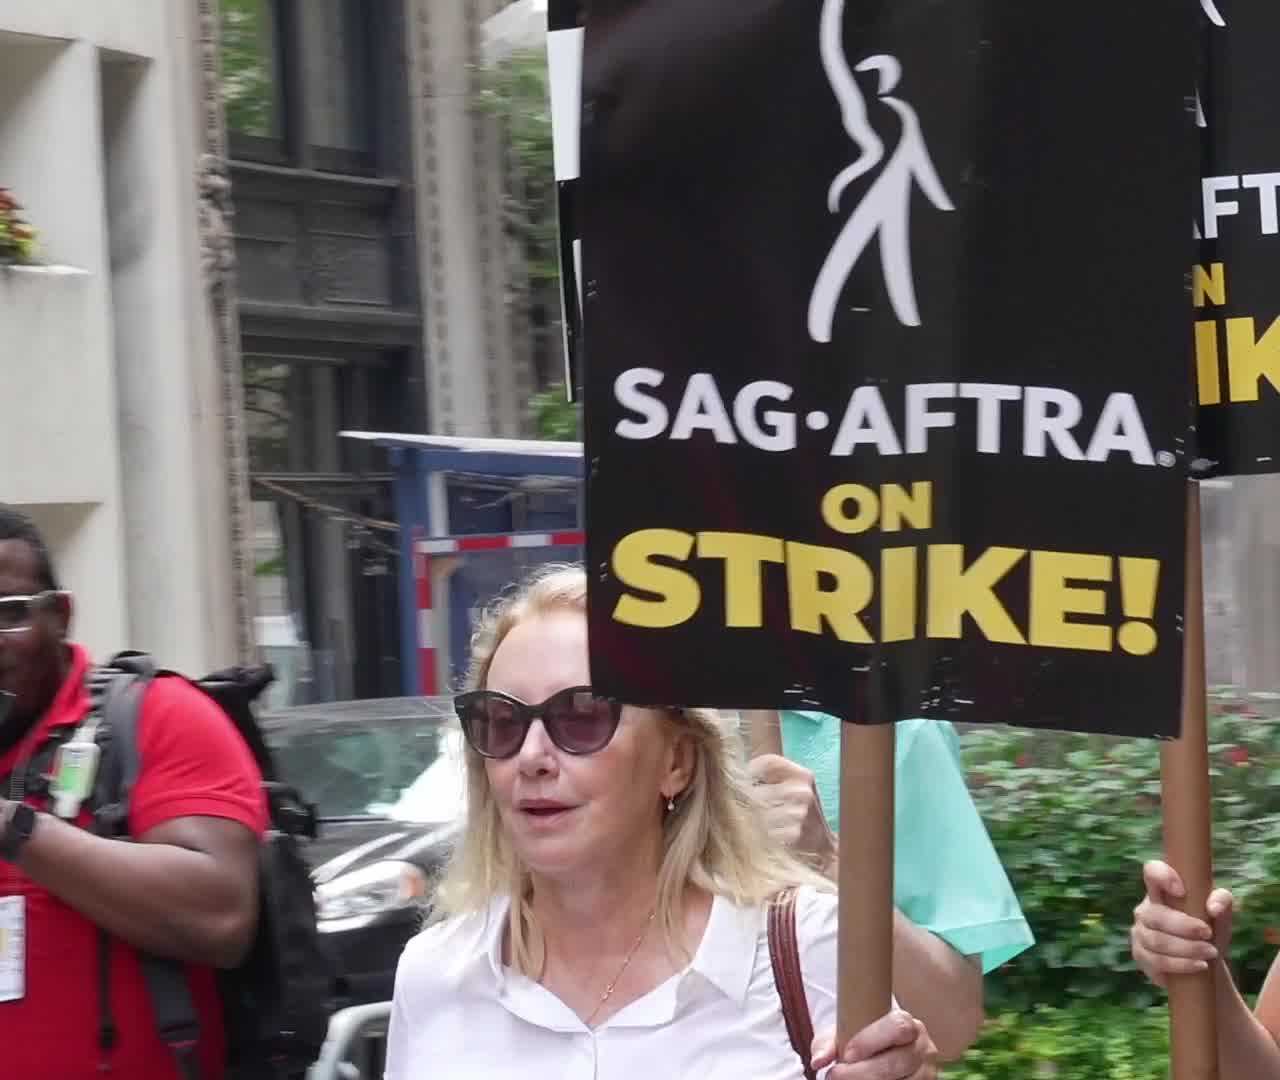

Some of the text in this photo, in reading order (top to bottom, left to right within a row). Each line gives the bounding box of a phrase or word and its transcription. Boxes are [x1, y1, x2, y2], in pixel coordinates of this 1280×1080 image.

[1191, 262, 1226, 308] N
[821, 480, 933, 534] ON
[611, 527, 1161, 656] STRIKE!
